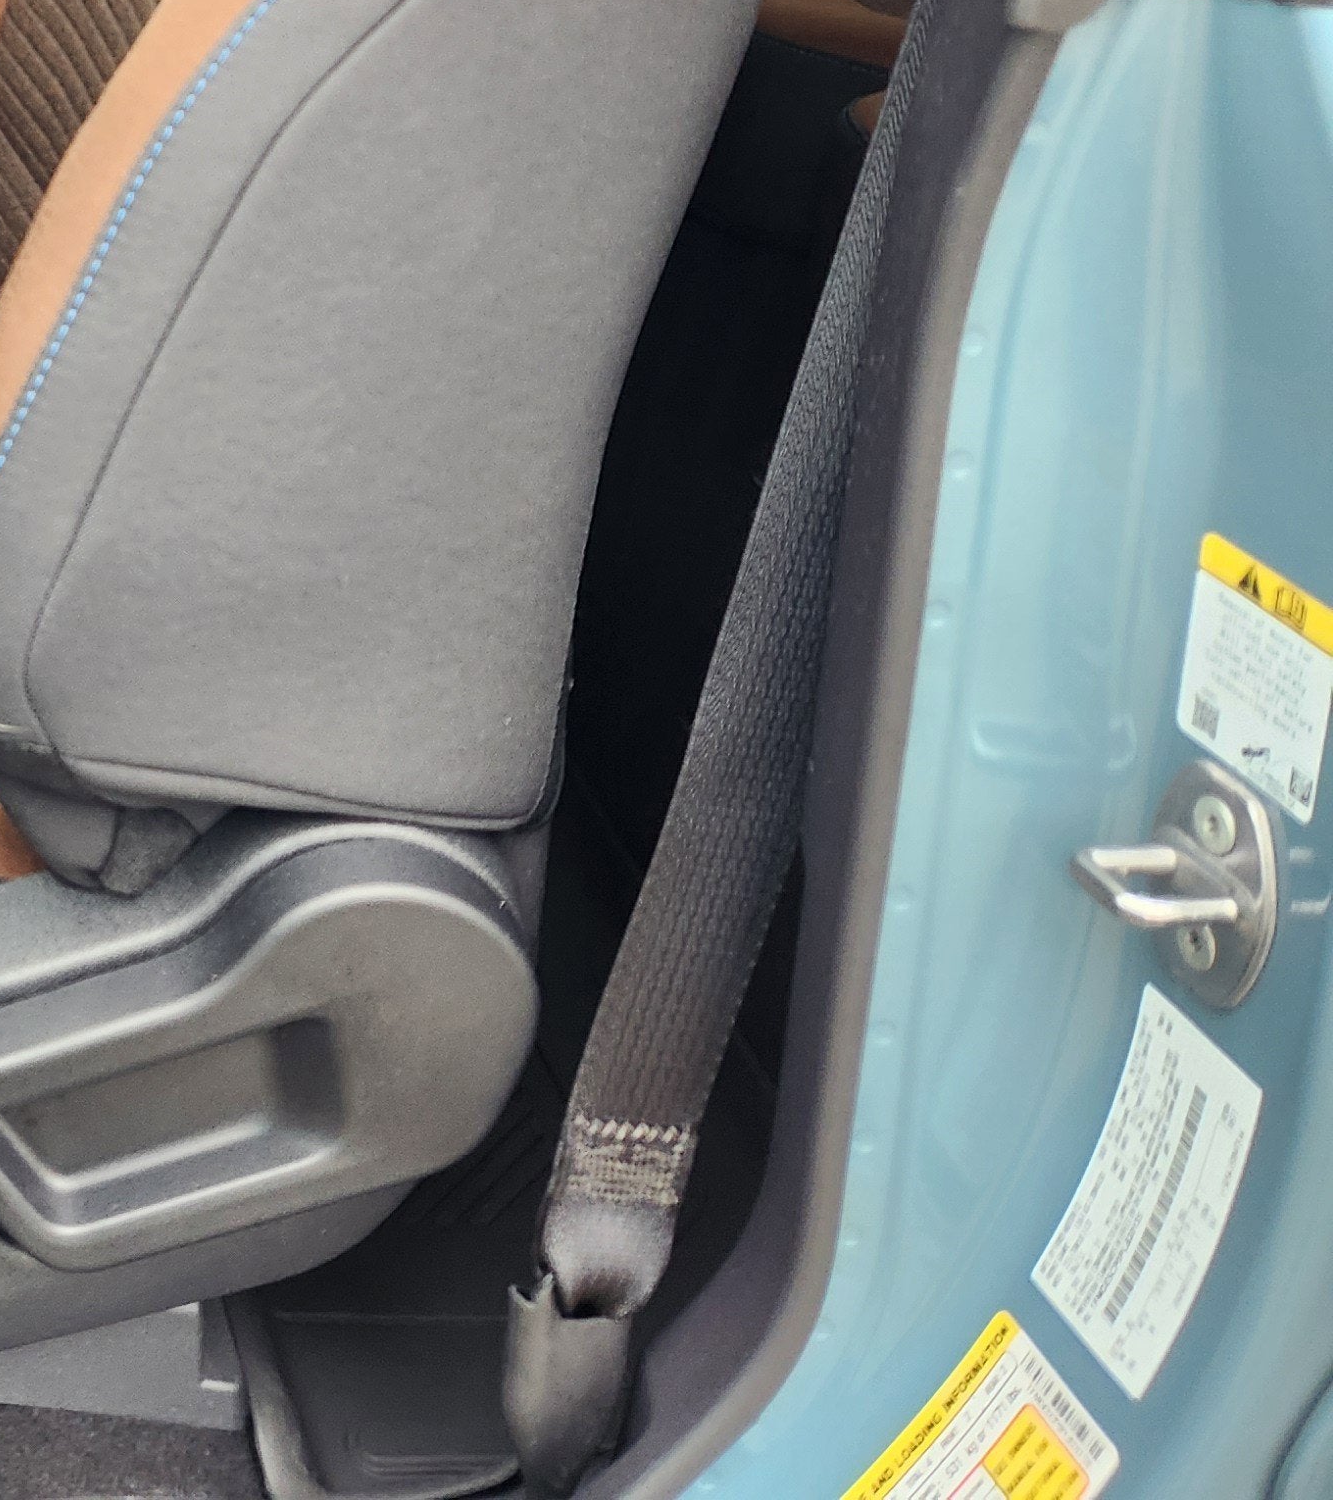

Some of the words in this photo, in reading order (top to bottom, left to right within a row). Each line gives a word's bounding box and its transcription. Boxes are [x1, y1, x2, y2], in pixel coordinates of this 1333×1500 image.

[871, 1467, 894, 1494] AND
[894, 1411, 943, 1468] LOADING
[941, 1323, 1009, 1413] INFORMATION
